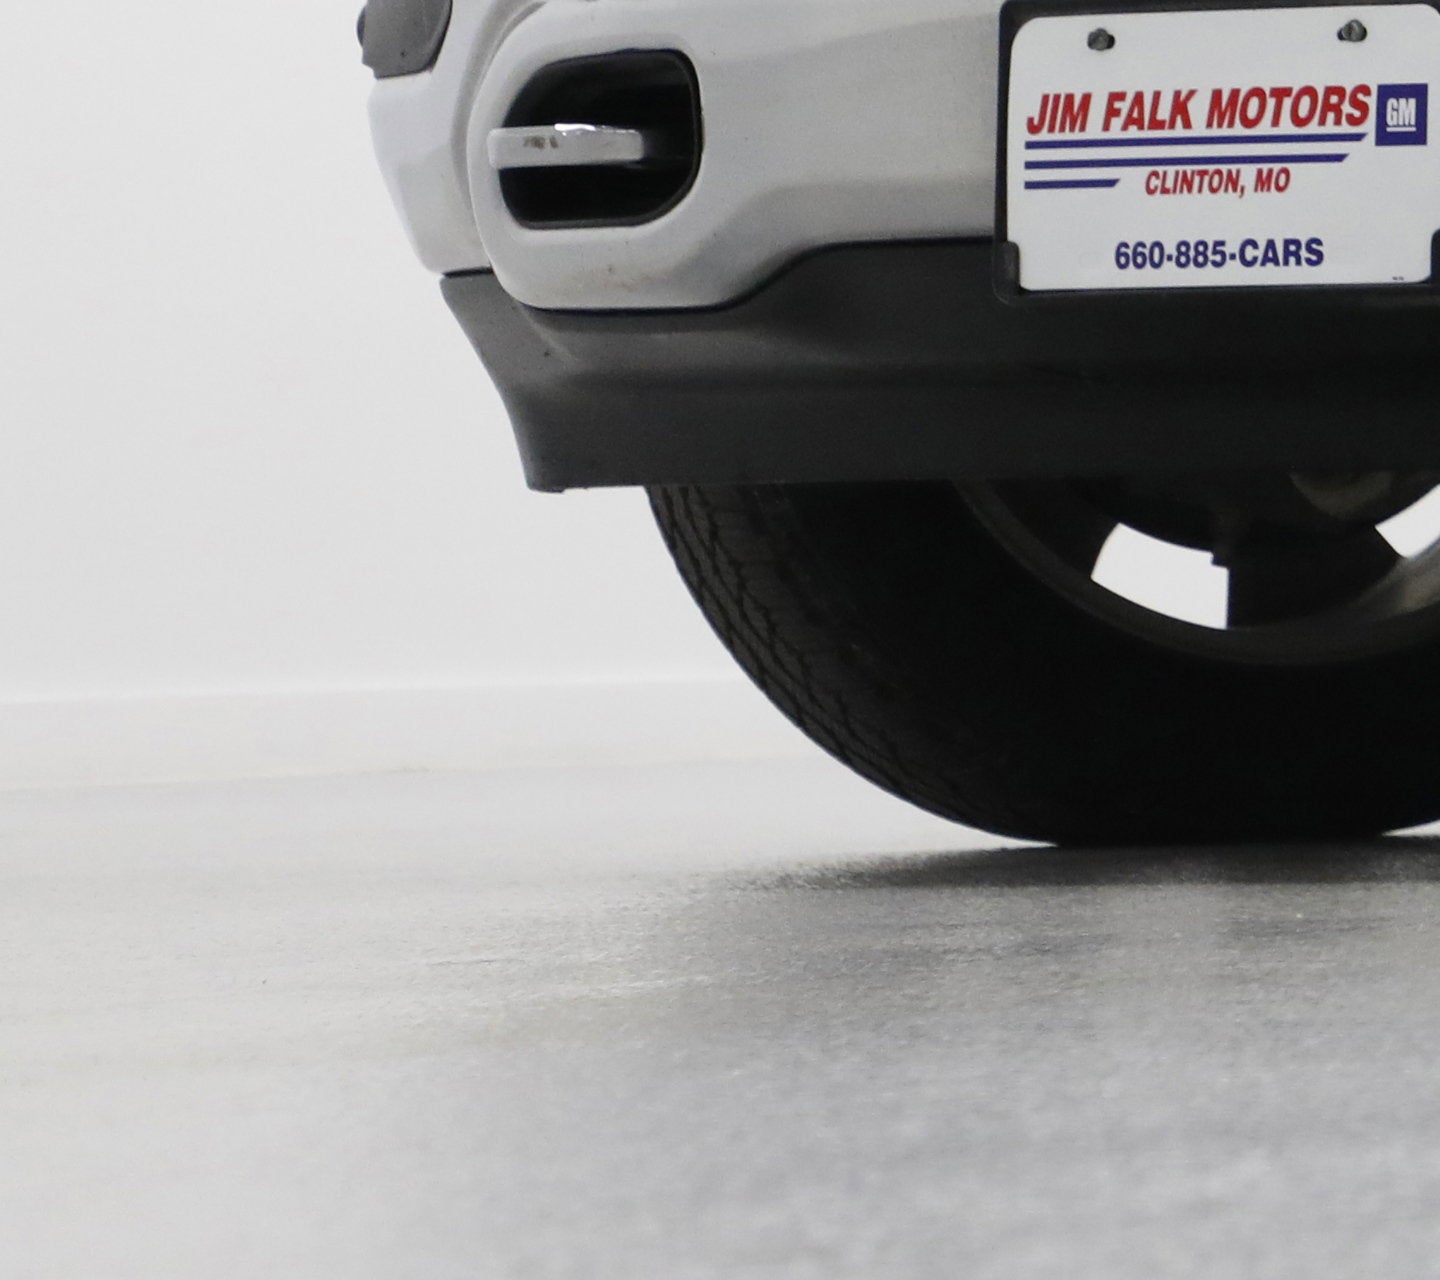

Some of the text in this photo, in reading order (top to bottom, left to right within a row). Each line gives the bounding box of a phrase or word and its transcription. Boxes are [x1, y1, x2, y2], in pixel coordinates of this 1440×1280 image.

[1026, 83, 1372, 135] JIM FALK MOTORS
[1385, 97, 1417, 128] GM
[1144, 166, 1291, 198] CLINTON, MO
[1114, 237, 1325, 270] 660-885-CARS
